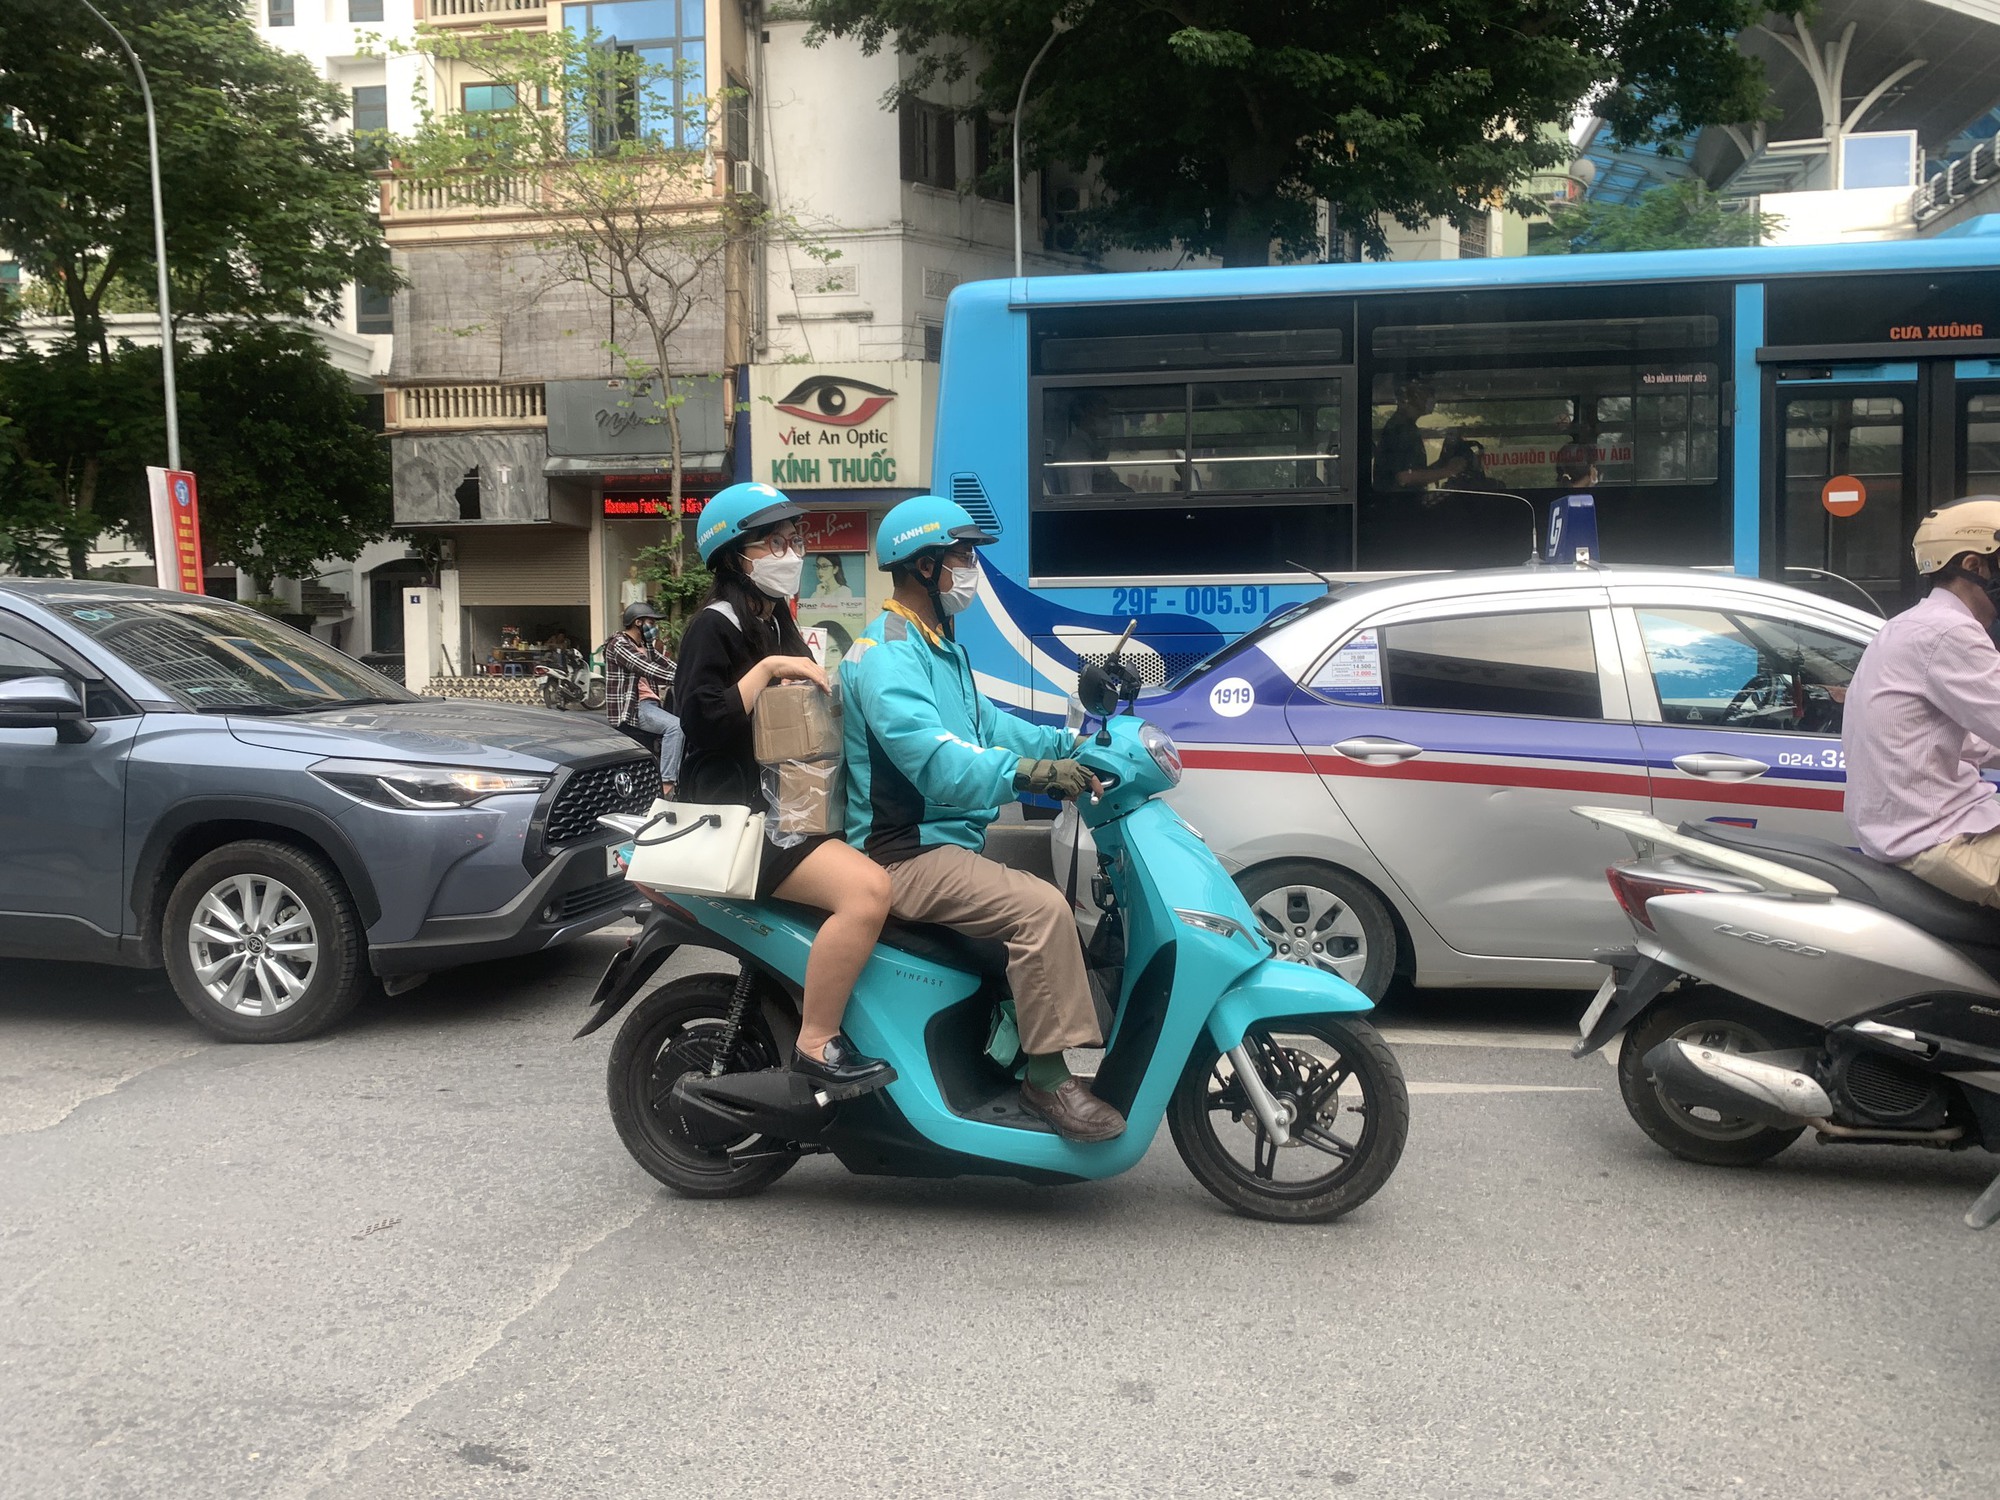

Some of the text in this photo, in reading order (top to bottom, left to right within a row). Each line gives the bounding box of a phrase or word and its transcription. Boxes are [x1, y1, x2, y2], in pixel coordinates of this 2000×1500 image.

[818, 430, 840, 445] An
[846, 429, 888, 448] Optic
[771, 448, 896, 483] KÍNH THUỐC
[1112, 587, 1158, 617] 29F
[1185, 585, 1270, 614] 005.91
[1214, 687, 1250, 704] 1919
[1713, 923, 1827, 957] LEAD
[895, 969, 944, 987] VINFAST
